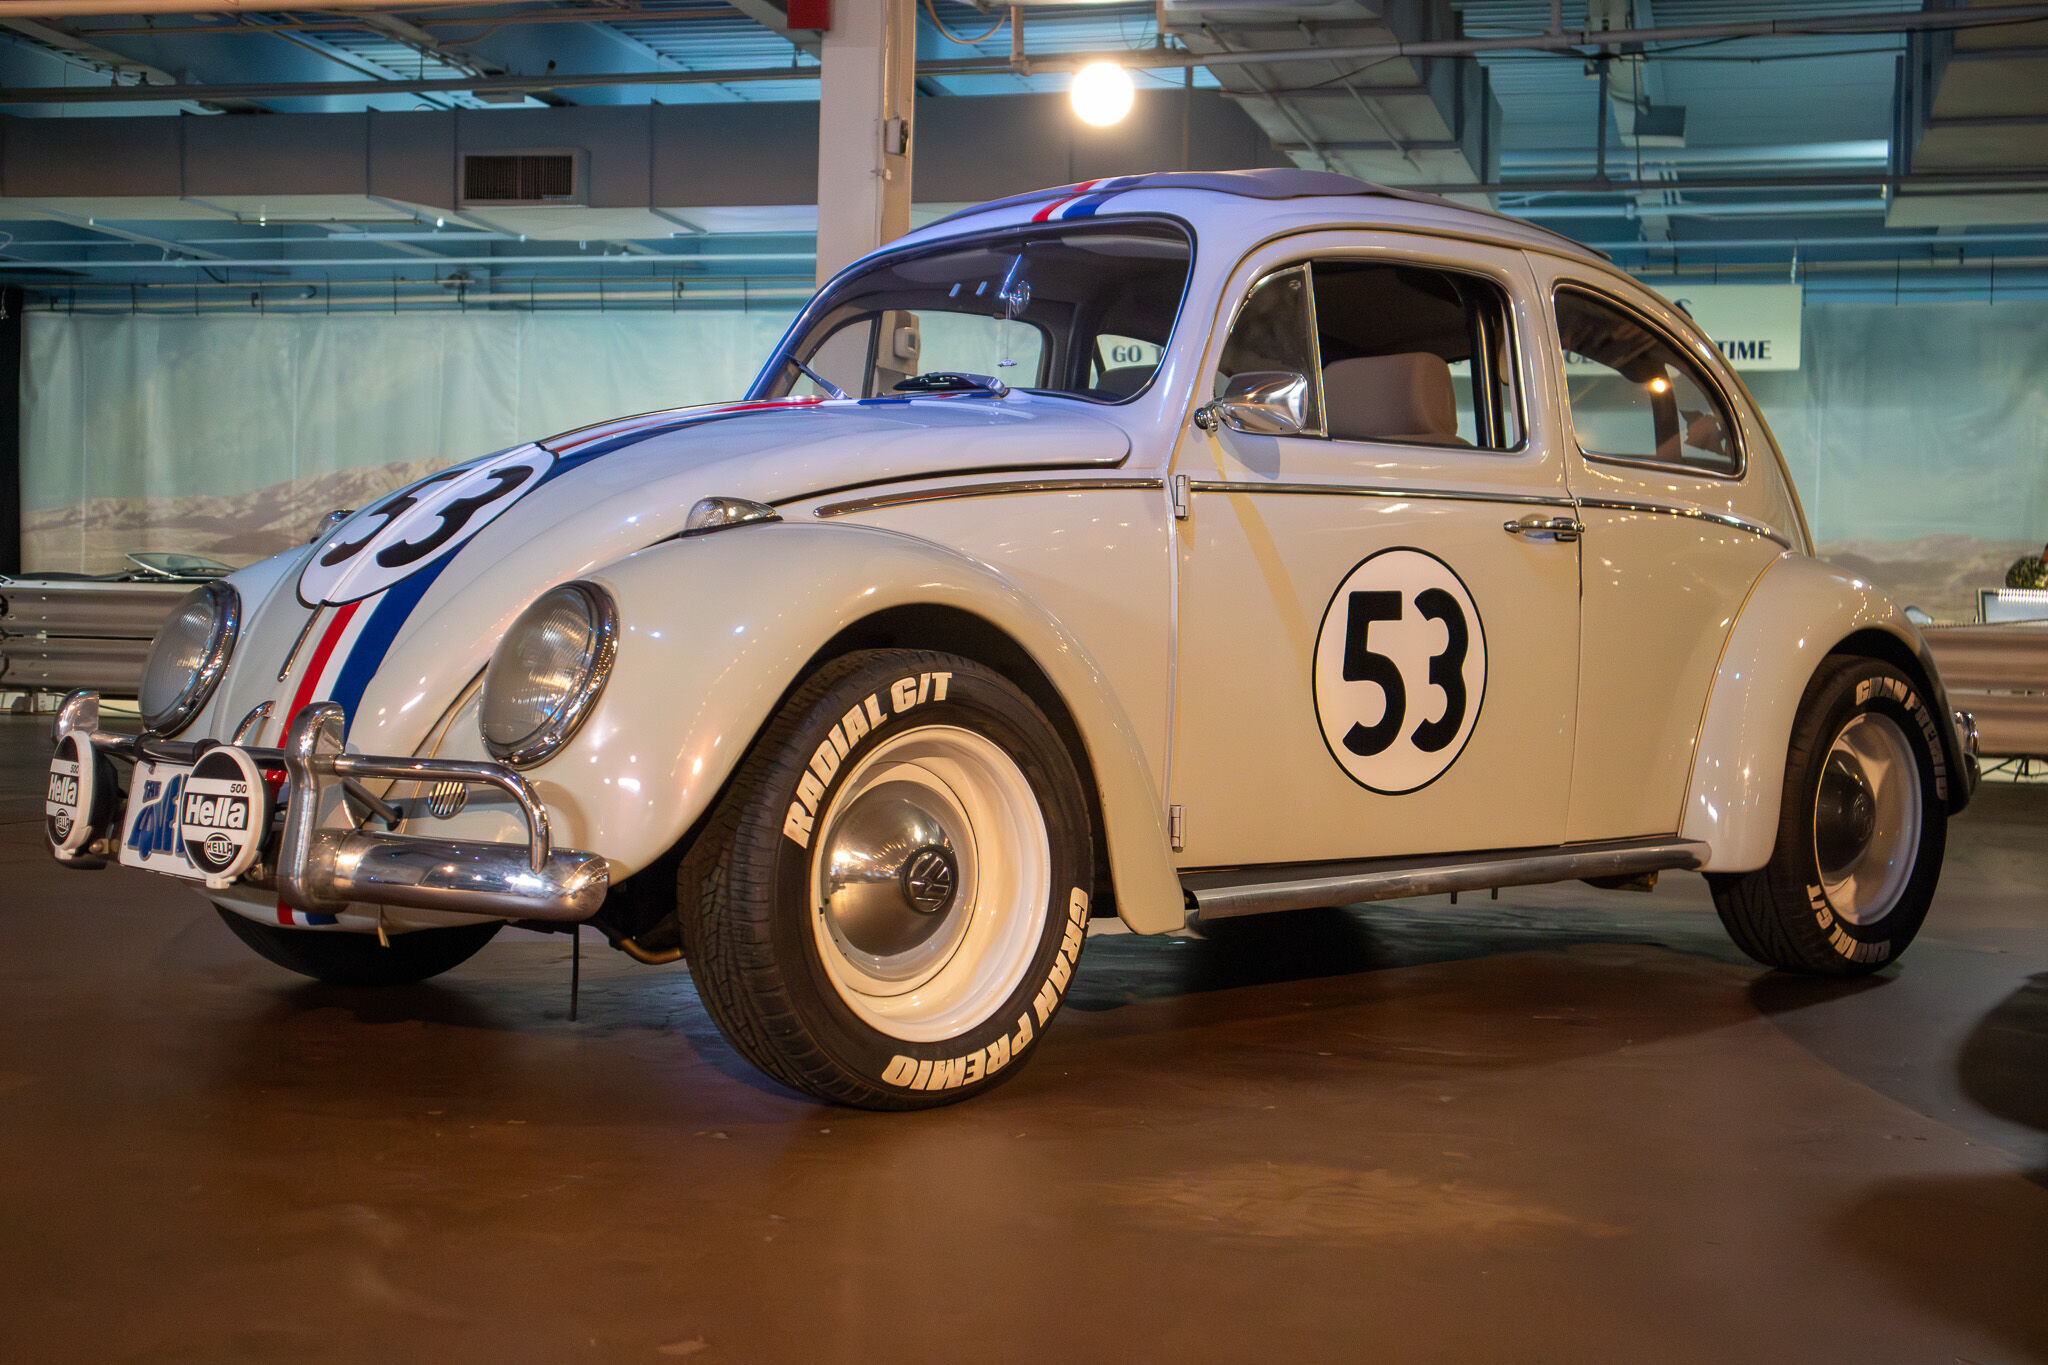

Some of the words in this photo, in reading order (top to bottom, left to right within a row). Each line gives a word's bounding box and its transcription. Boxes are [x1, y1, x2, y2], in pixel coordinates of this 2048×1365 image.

[1112, 345, 1142, 363] GO
[1342, 587, 1469, 757] 53
[783, 693, 888, 849] RADIAL
[47, 773, 78, 806] Hella
[230, 783, 248, 795] 500
[185, 794, 247, 829] Hella
[206, 839, 234, 856] HELLA
[1033, 887, 1089, 1028] GRAN
[881, 1011, 1034, 1091] PREMIO
